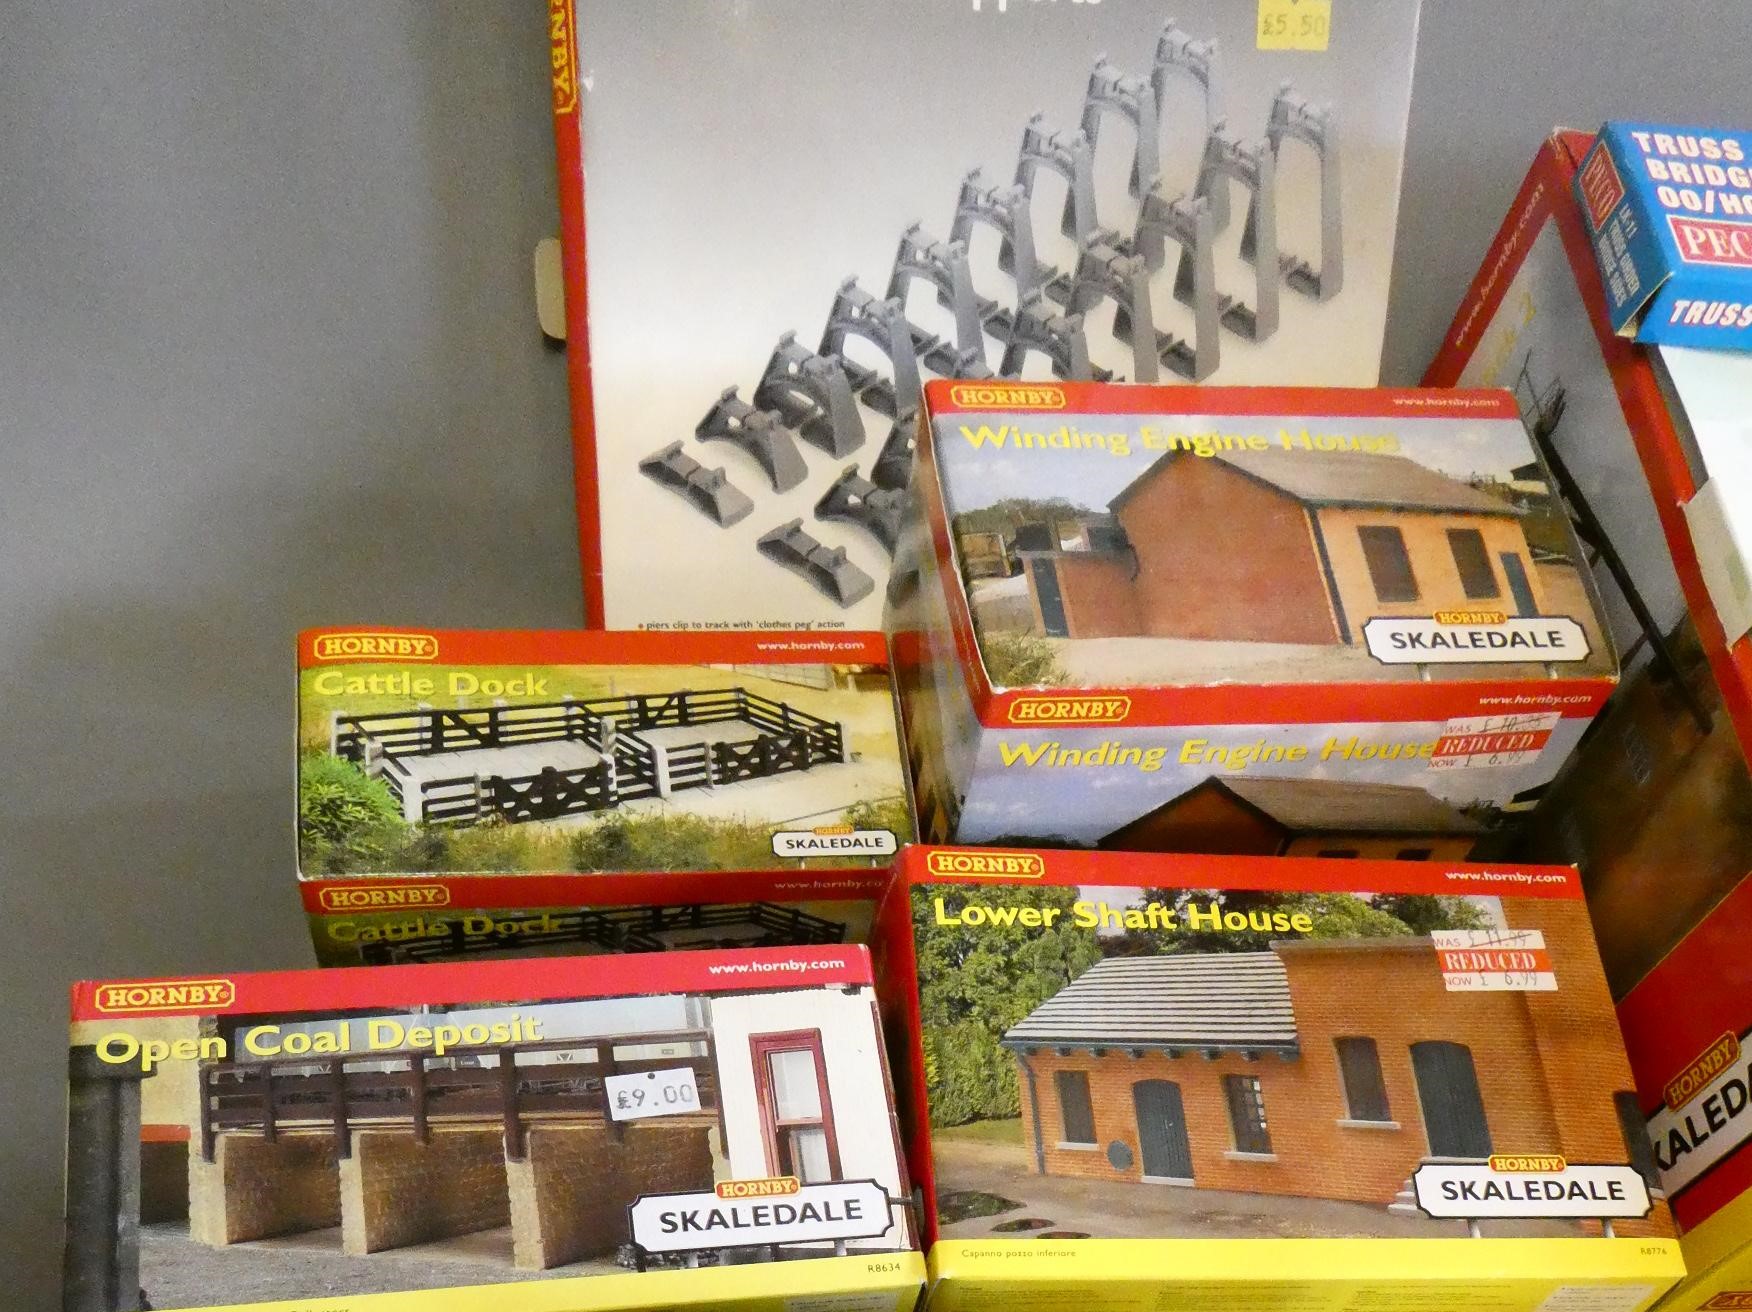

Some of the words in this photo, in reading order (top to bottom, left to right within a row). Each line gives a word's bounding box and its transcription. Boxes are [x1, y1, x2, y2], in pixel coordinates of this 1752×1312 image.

[1261, 13, 1327, 37] £5.50
[1631, 131, 1745, 162] TRUSS
[1645, 157, 1752, 189] BRIDG
[1669, 299, 1752, 328] TRUSS
[961, 389, 1054, 406] HORNBY
[1392, 397, 1501, 409] www.hornby.com
[959, 424, 1132, 457] Winding
[1139, 424, 1270, 458] Engine
[1279, 428, 1401, 453] House
[646, 621, 669, 631] piers
[672, 620, 689, 631] clip
[692, 621, 702, 629] to
[705, 620, 729, 629] track
[733, 620, 753, 629] with
[817, 620, 845, 629] action
[1437, 612, 1502, 625] HORNBY
[324, 638, 427, 655] HORNBY
[756, 641, 865, 652] www.hornby.com
[1390, 630, 1567, 650] SKALEDALE
[313, 671, 436, 696] Cattle
[449, 672, 549, 696] Dock
[1478, 694, 1592, 706] www.hornby.com
[1017, 701, 1117, 720] HORNBY
[1444, 724, 1472, 735] WAS
[1442, 733, 1535, 754] REDUCED
[999, 741, 1167, 771] Winding
[1178, 739, 1308, 772] Engine
[1319, 735, 1435, 760] House
[1427, 758, 1457, 769] NOW
[786, 837, 885, 850] SKALEDALE
[936, 855, 1034, 874] HORNBY
[773, 879, 883, 890] www.hornby.co
[1445, 871, 1567, 884] www.hornby.com
[330, 887, 440, 907] HORNBY
[934, 898, 1062, 927] Lower
[1075, 897, 1177, 930] Shaft
[1189, 902, 1313, 932] House
[327, 917, 450, 943] Cattle
[462, 913, 564, 937] Dock
[1434, 936, 1461, 947] WAS
[709, 958, 845, 975] www.hornby.com
[1444, 951, 1537, 971] REDUCED
[1446, 976, 1472, 986] NOW
[107, 985, 221, 1007] HORNBY
[95, 1032, 227, 1072] Open
[244, 1021, 351, 1057] Coal
[368, 1013, 545, 1055] Deposit
[1669, 1038, 1733, 1106] HORNBY
[615, 1083, 695, 1110] £9.00
[1494, 1157, 1559, 1172] HORNBY
[721, 1179, 794, 1198] HORNBY
[1440, 1180, 1626, 1201] SKALEDALE
[659, 1198, 864, 1234] SKALEDALE
[867, 1262, 902, 1274] R8634
